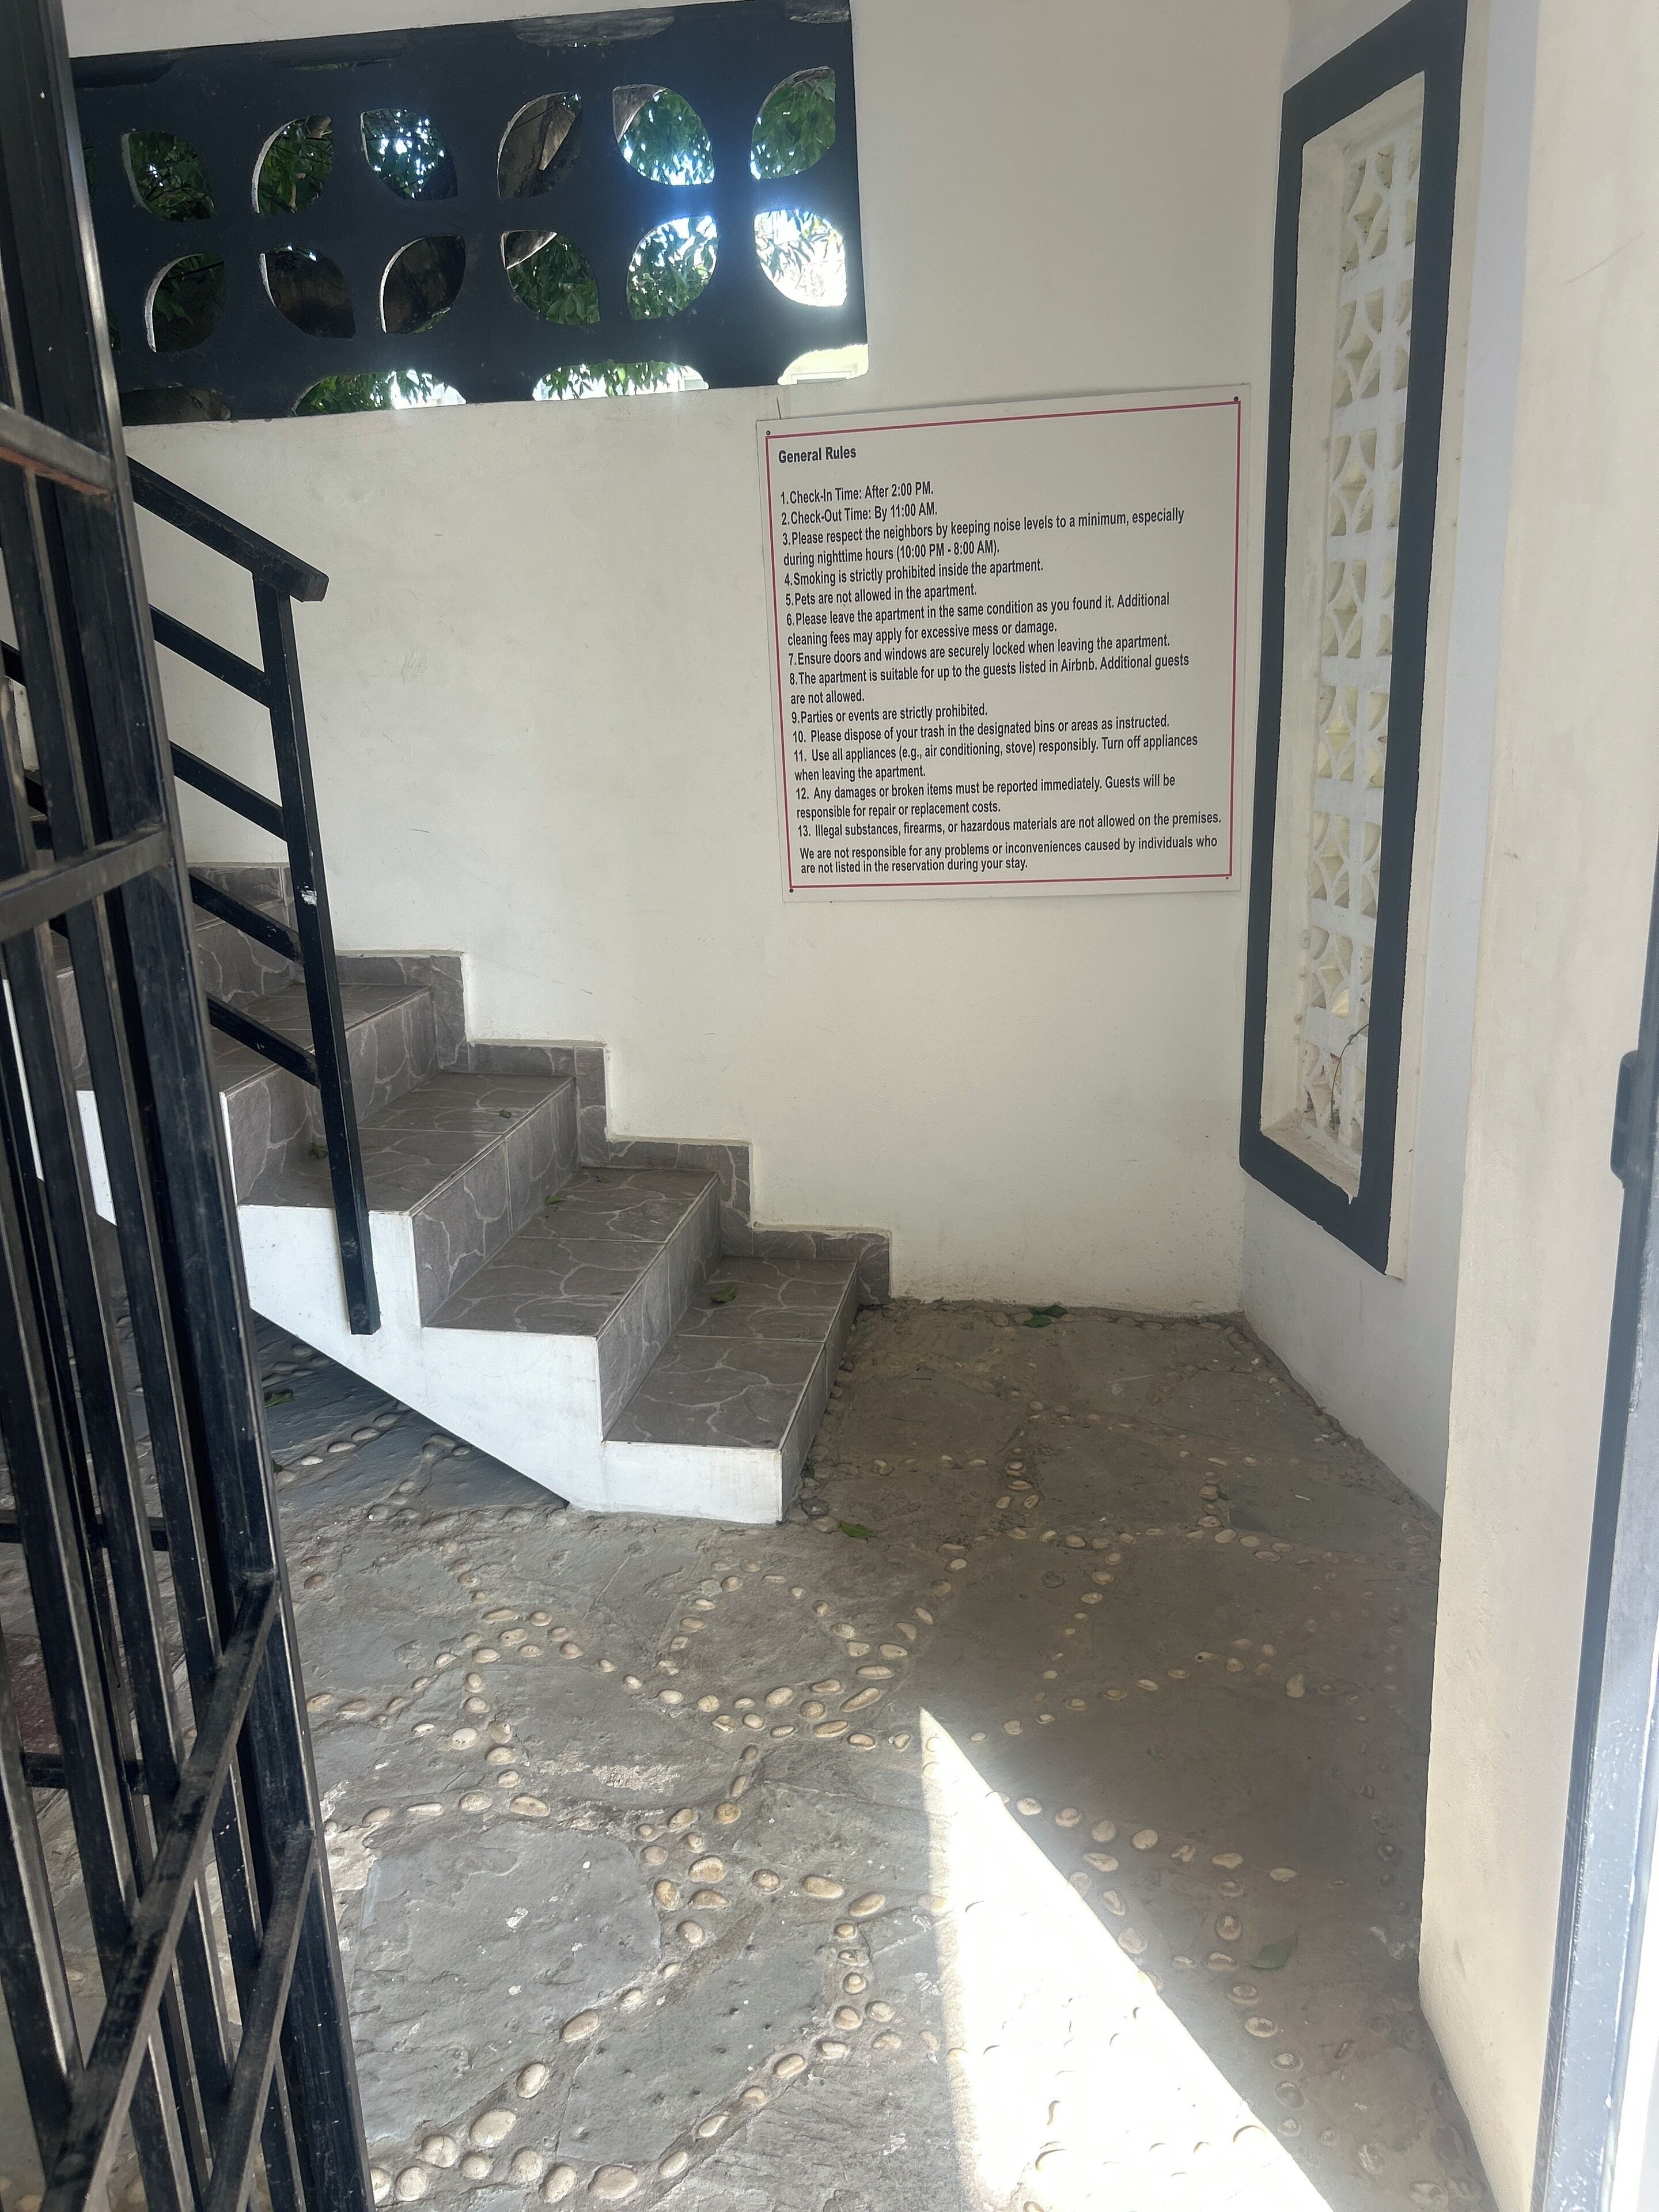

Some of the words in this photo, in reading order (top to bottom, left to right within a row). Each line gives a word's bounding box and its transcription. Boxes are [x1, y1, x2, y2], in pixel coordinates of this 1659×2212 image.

[778, 446, 822, 464] General
[825, 445, 857, 460] Rules
[834, 487, 862, 501] Time:
[864, 484, 889, 499] After
[891, 482, 912, 497] 2:00
[915, 480, 933, 495] PM.
[826, 528, 863, 546] respect
[865, 526, 880, 540] the
[883, 523, 933, 541] neighbors
[935, 521, 948, 539] by
[950, 519, 990, 537] keeping
[993, 517, 1021, 532] noise
[1024, 514, 1054, 531] levels
[1055, 514, 1066, 528] to
[1069, 516, 1075, 528] a
[1078, 511, 1129, 527] minimum,
[1131, 506, 1184, 527] especially
[783, 551, 815, 568] during
[817, 548, 863, 567] nighttime
[865, 547, 893, 561] hours
[896, 544, 926, 563] (10:00
[929, 542, 945, 557] PM
[953, 540, 975, 555] 8:00
[976, 539, 999, 557] AM).
[829, 610, 855, 624] leave
[857, 608, 873, 623] the
[875, 605, 925, 624] apartment
[927, 605, 936, 619] in
[938, 604, 955, 618] the
[957, 605, 984, 617] same
[986, 599, 1033, 615] condition
[1036, 601, 1048, 613] as
[1050, 600, 1069, 615] you
[1072, 595, 1102, 611] found
[1105, 594, 1114, 609] it.
[1116, 591, 1169, 608] Additional
[787, 631, 828, 647] cleaning
[829, 630, 850, 644] fees
[853, 631, 873, 645] may
[875, 627, 902, 645] apply
[904, 626, 919, 640] for
[921, 623, 969, 639] excessive
[972, 624, 998, 637] mess
[1001, 623, 1012, 635] or
[1014, 620, 1057, 636] damage.
[819, 669, 867, 687] apartment
[869, 668, 877, 681] is
[880, 666, 918, 681] suitable
[920, 665, 935, 679] for
[937, 667, 950, 681] up
[952, 664, 962, 677] to
[964, 662, 980, 677] the
[983, 661, 1016, 679] guests
[1018, 659, 1046, 675] listed
[1049, 659, 1058, 673] in
[1060, 657, 1097, 672] Airbnb.
[1099, 654, 1152, 671] Additional
[1154, 653, 1189, 671] guests
[790, 694, 805, 705] are
[808, 691, 824, 704] not
[825, 688, 865, 703] allowed.
[793, 730, 806, 743] 10.
[810, 729, 842, 743] Please
[844, 728, 881, 744] dispose
[884, 726, 894, 740] of
[895, 728, 918, 743] your
[919, 724, 945, 738] trash
[947, 724, 956, 737] in
[959, 722, 975, 736] the
[977, 719, 1031, 738] designated
[1033, 719, 1055, 733] bins
[1058, 721, 1069, 732] or
[1071, 720, 1099, 732] areas
[1101, 719, 1113, 730] as
[1115, 713, 1169, 729] instructed.
[793, 749, 806, 762] 11.
[811, 748, 830, 762] Use
[832, 747, 843, 761] all
[845, 746, 896, 763] appliances
[899, 745, 922, 762] (e.g.,
[925, 743, 938, 757] air
[940, 741, 1003, 757] conditioning,
[1005, 739, 1036, 756] stove)
[1039, 737, 1099, 755] responsibly.
[1101, 736, 1124, 750] Turn
[1126, 734, 1141, 749] off
[1143, 733, 1198, 751] appliances
[794, 768, 819, 781] when
[821, 766, 855, 782] leaving
[857, 766, 873, 779] the
[875, 764, 926, 782] apartment.
[796, 787, 809, 800] 12.
[813, 786, 832, 802] Any
[834, 785, 877, 801] damages
[878, 787, 889, 797] or
[891, 783, 925, 797] broken
[927, 782, 953, 796] items
[955, 781, 980, 795] must
[982, 780, 994, 793] be
[997, 778, 1038, 796] reported
[1040, 776, 1102, 793] immediately.
[1105, 775, 1140, 789] Guests
[1143, 773, 1160, 787] will
[1163, 772, 1175, 786] be
[796, 804, 851, 821] responsible
[852, 804, 866, 817] for
[868, 802, 896, 819] repair
[898, 805, 908, 816] or
[911, 801, 969, 818] replacement
[971, 800, 1001, 813] costs.
[797, 824, 811, 837] 13.
[815, 823, 843, 839] Illegal
[844, 823, 901, 836] substances,
[903, 821, 945, 835] firearms,
[947, 823, 958, 833] or
[960, 819, 1010, 832] hazardous
[1013, 816, 1058, 831] materials
[1060, 819, 1075, 830] are
[1078, 815, 1094, 828] not
[1097, 813, 1135, 828] allowed
[1138, 816, 1150, 826] on
[1153, 812, 1169, 826] the
[1172, 810, 1221, 828] premises.
[799, 847, 815, 859] We
[817, 849, 832, 859] are
[834, 846, 850, 859] not
[851, 844, 907, 861] responsible
[908, 844, 923, 857] for
[925, 846, 942, 859] any
[944, 842, 990, 859] problems
[992, 844, 1003, 854] or
[1005, 839, 1082, 854] inconveniences
[1084, 838, 1120, 851] caused
[1123, 837, 1135, 853] by
[1138, 835, 1194, 850] individuals
[1195, 834, 1218, 847] who
[801, 864, 816, 874] are
[817, 861, 834, 873] not
[835, 860, 861, 873] listed
[863, 860, 872, 872] in
[874, 859, 889, 872] the
[891, 858, 945, 872] reservation
[946, 857, 978, 873] during
[980, 859, 1003, 873] your
[1005, 857, 1028, 872] stay.
